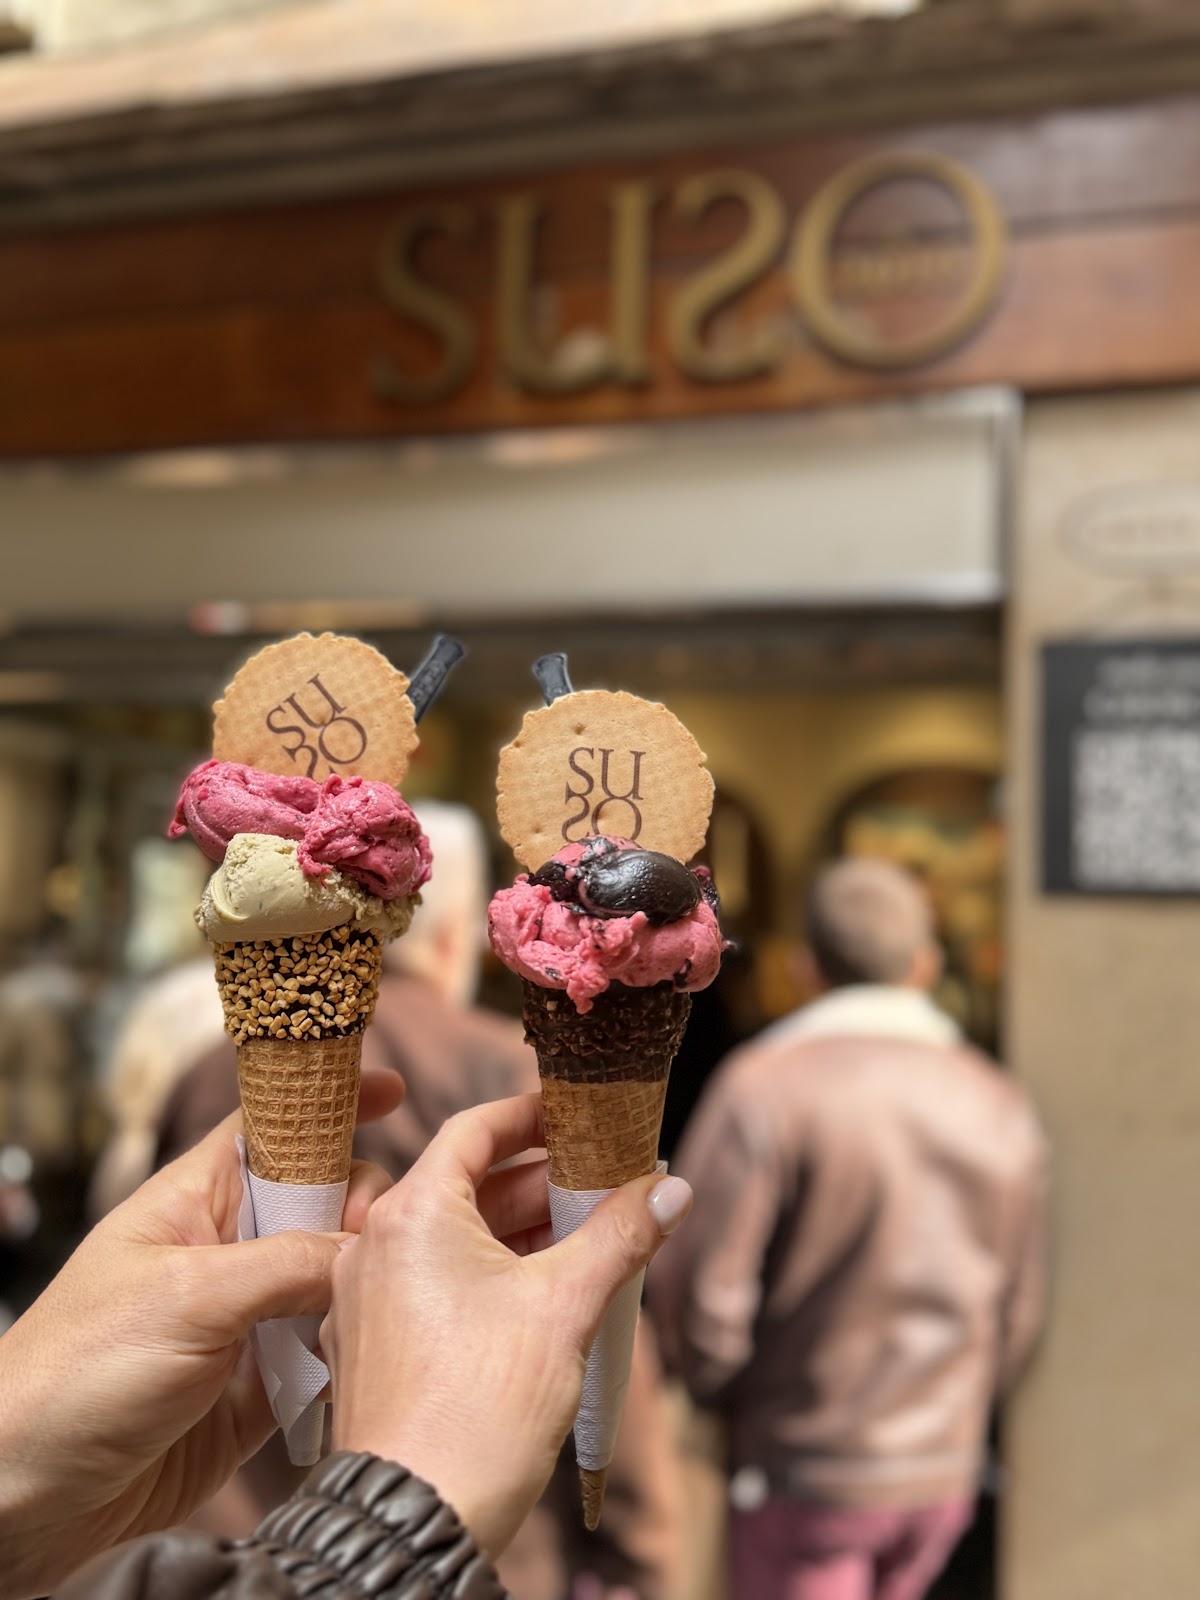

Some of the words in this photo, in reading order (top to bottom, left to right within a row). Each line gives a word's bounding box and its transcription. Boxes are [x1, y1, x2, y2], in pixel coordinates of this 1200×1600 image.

[370, 152, 1005, 401] SUSO
[266, 673, 347, 752] SU
[565, 747, 646, 801] SU
